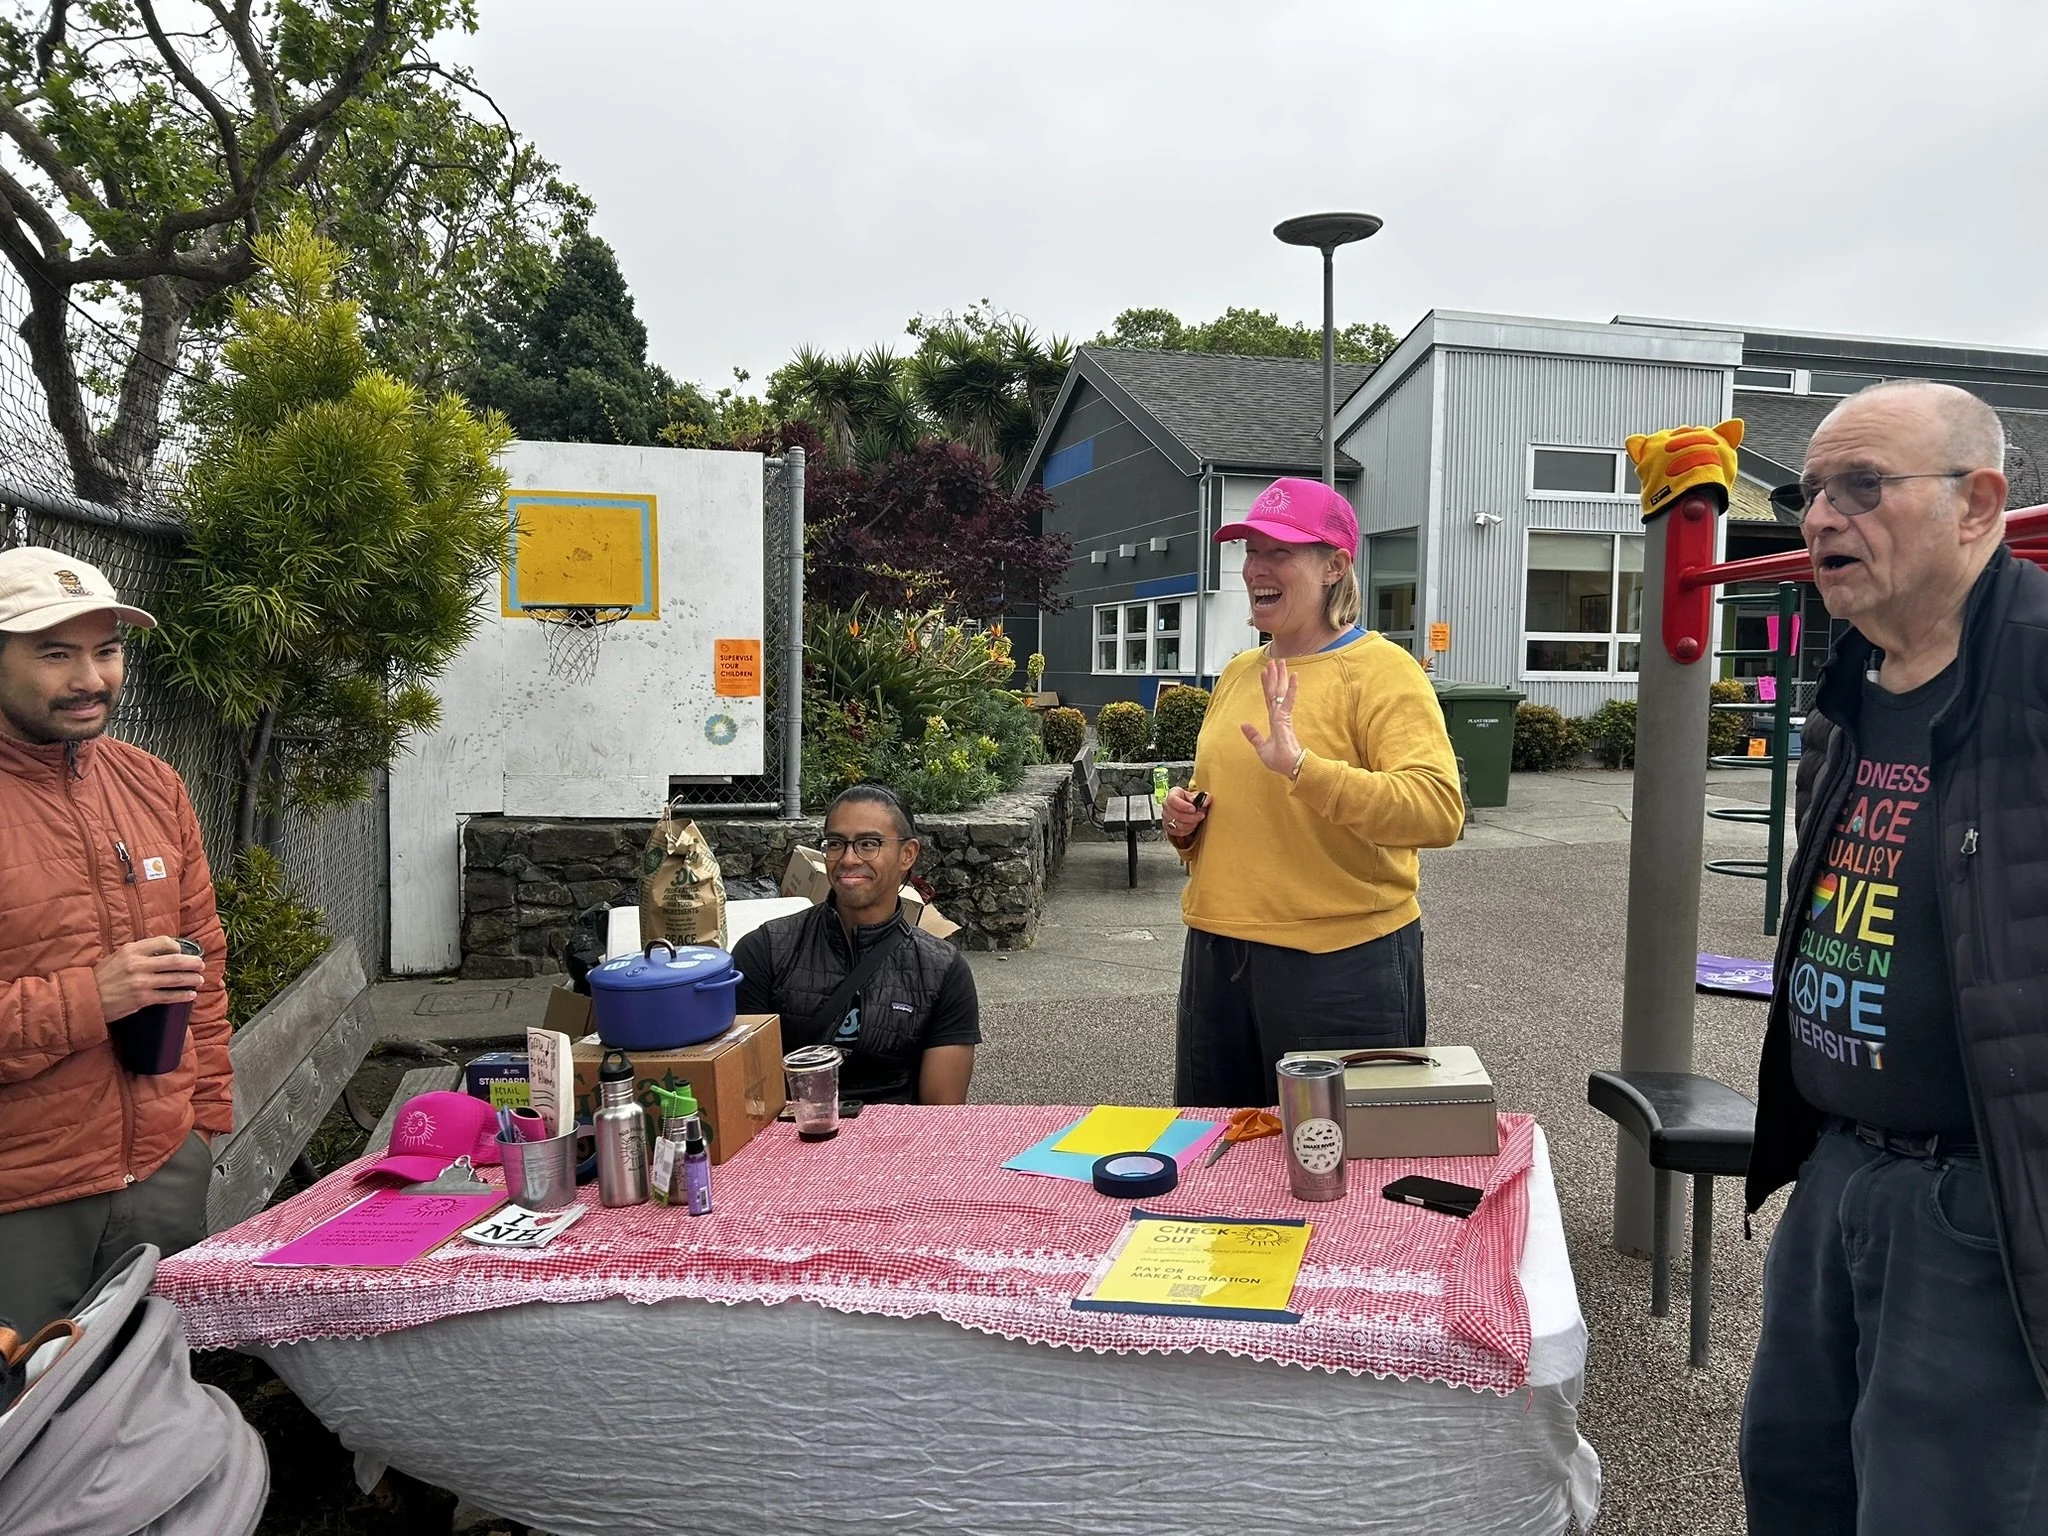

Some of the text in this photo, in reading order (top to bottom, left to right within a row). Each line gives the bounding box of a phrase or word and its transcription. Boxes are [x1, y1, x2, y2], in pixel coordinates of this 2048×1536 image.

[1855, 759, 1931, 794] DNESS
[665, 934, 698, 946] PEACE
[479, 1077, 526, 1086] STANDARD
[494, 1086, 520, 1096] RETAIL
[503, 1213, 534, 1227] I
[1159, 1225, 1238, 1236] CHECK-
[1153, 1235, 1196, 1244] OUT
[1187, 1275, 1260, 1284] DONATION
